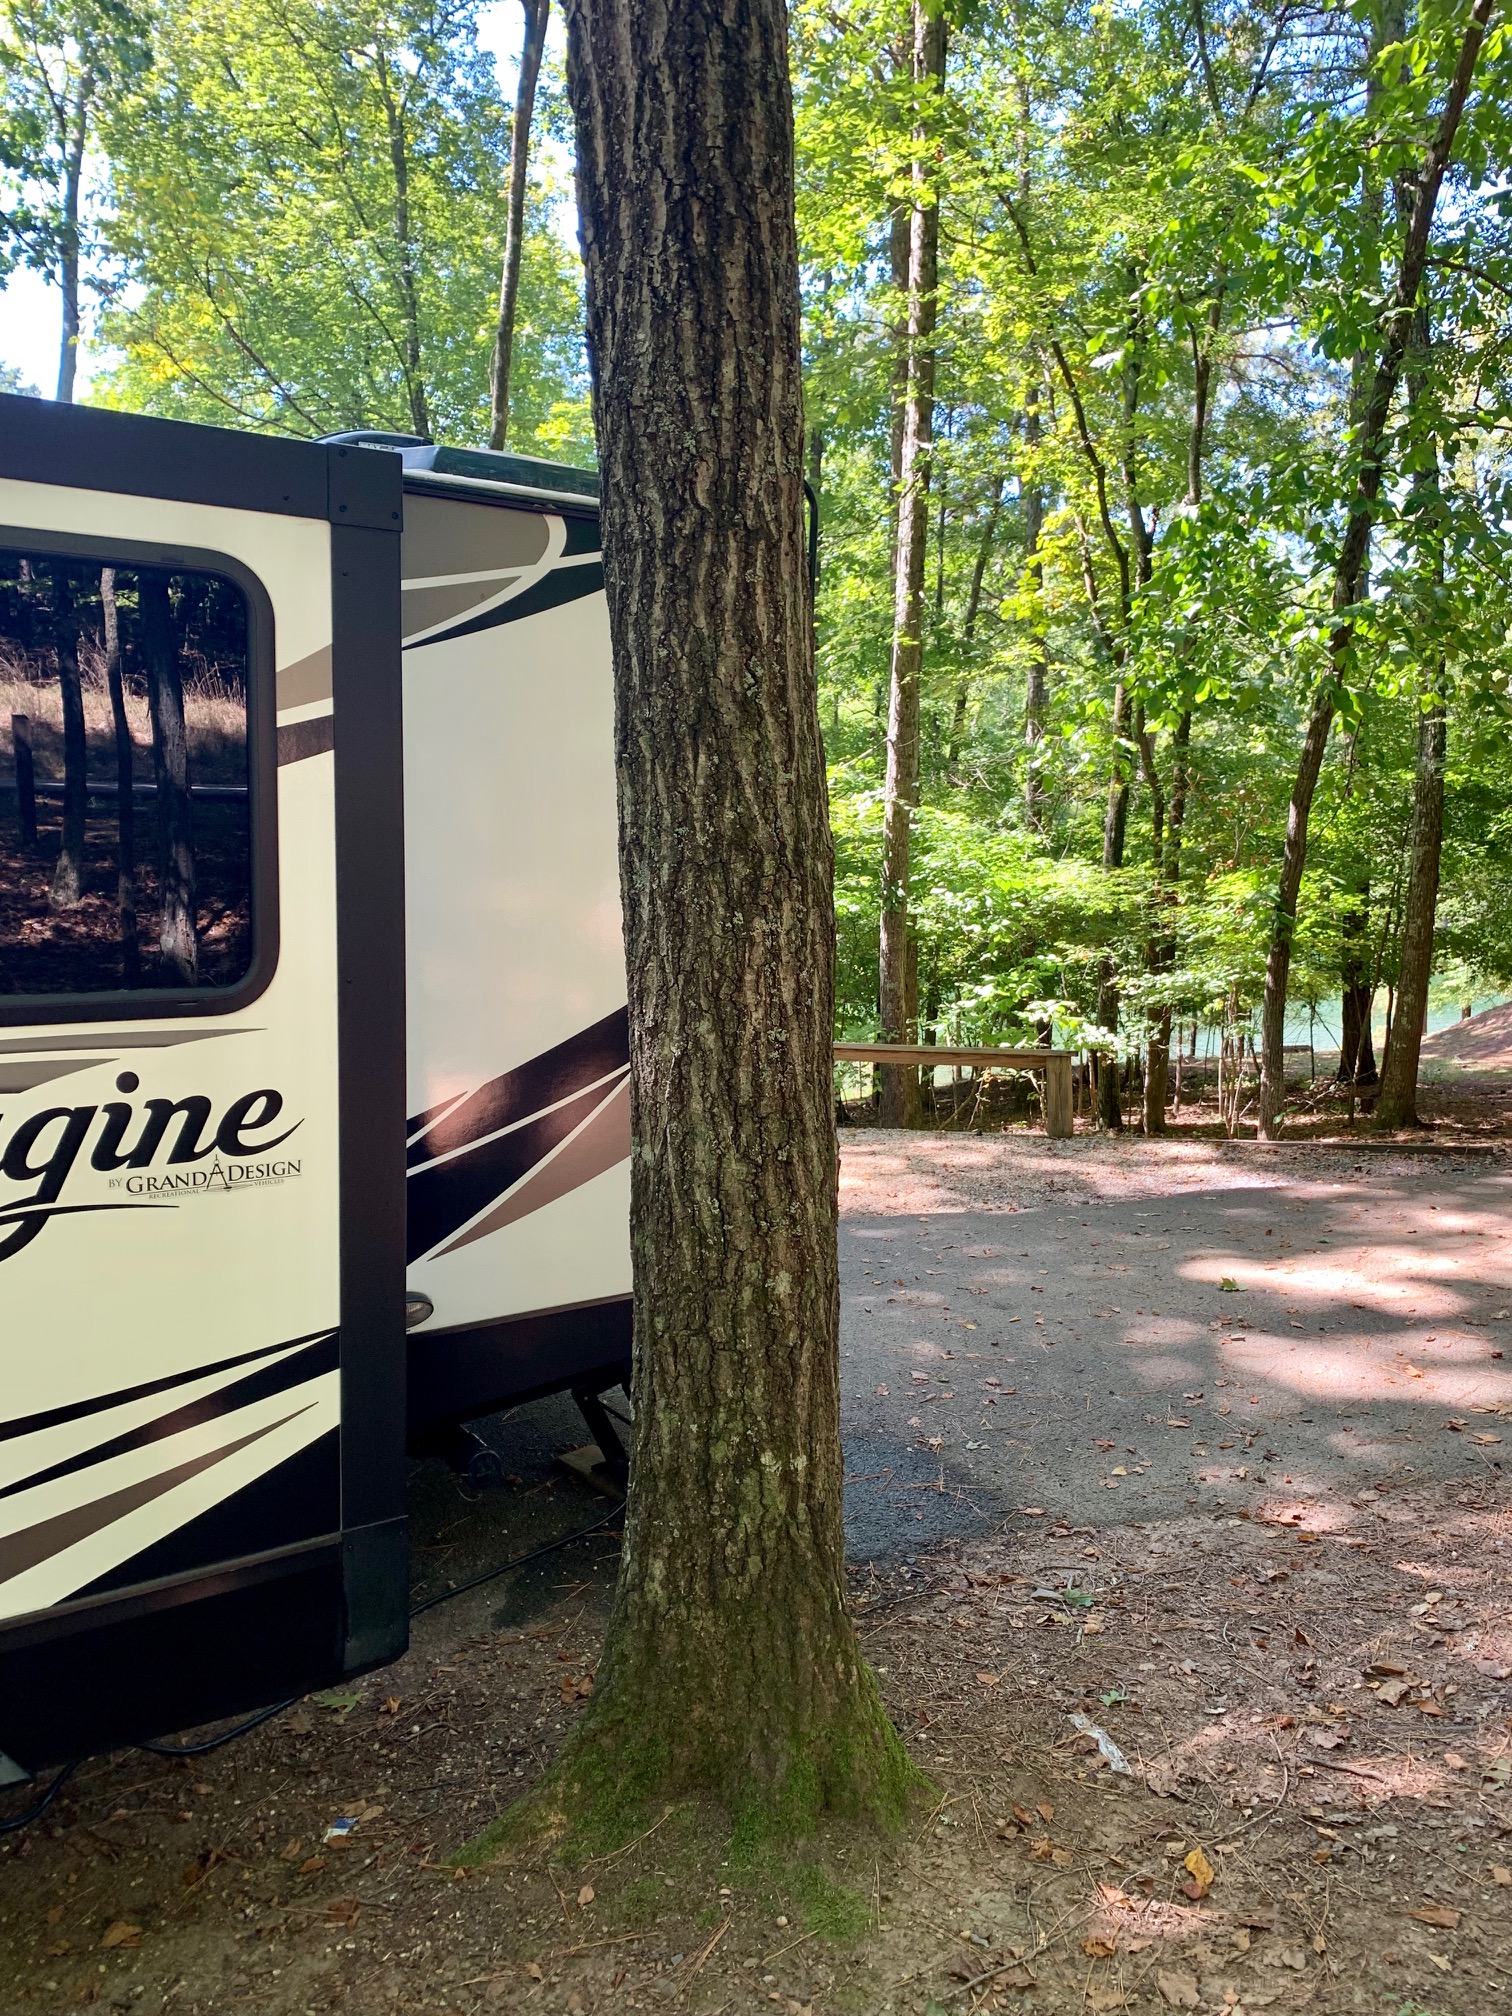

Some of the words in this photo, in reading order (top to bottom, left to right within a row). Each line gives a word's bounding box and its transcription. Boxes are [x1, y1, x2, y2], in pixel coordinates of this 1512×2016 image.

[0, 1071, 305, 1262] gine
[108, 1178, 123, 1188] BY
[126, 1171, 207, 1193] GRAND
[228, 1160, 301, 1182] DESIGN
[148, 1188, 200, 1200] RECREATIONAL
